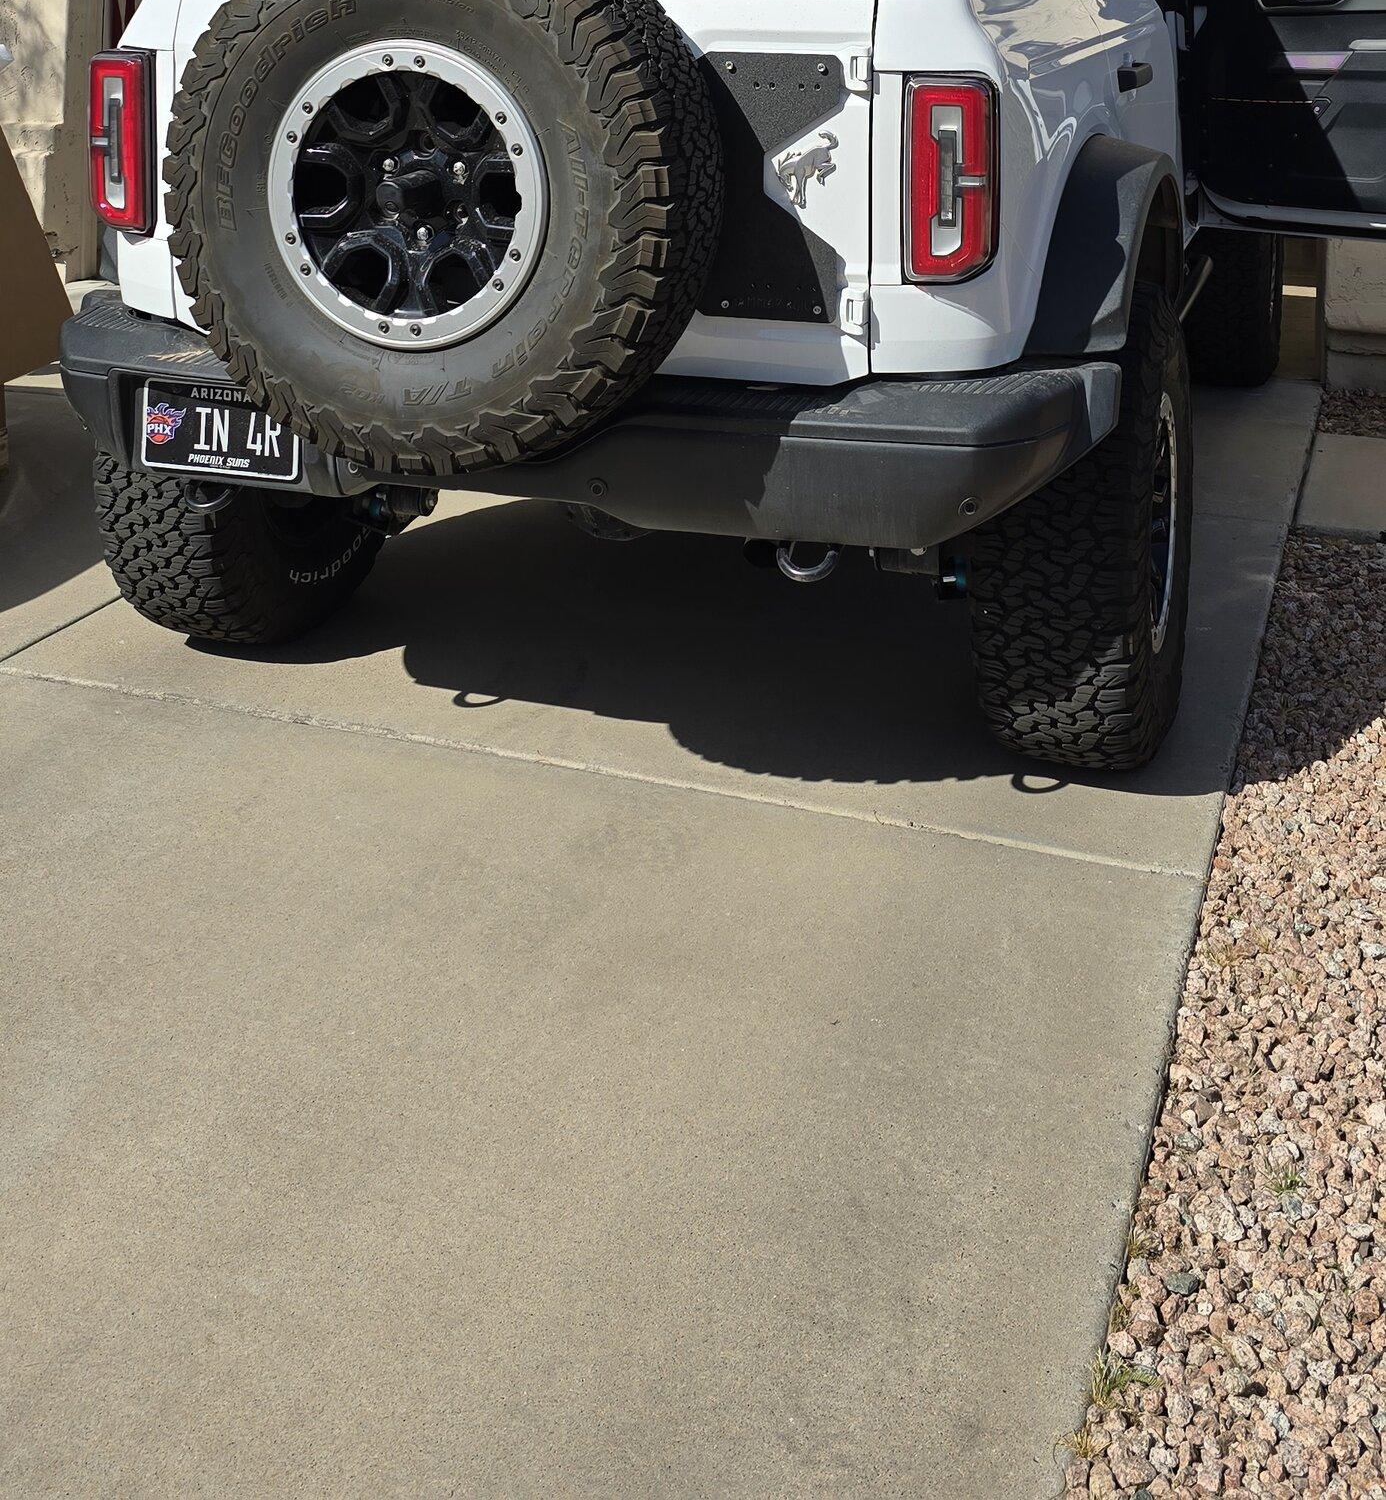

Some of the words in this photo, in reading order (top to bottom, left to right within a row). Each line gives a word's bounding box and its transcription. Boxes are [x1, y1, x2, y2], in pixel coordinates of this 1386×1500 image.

[490, 117, 590, 379] All-Terrain
[190, 387, 252, 403] ARIZONA
[147, 423, 172, 435] PHX
[194, 406, 230, 452] IN
[246, 411, 282, 458] 4R
[188, 453, 224, 466] PHOENIX
[226, 456, 251, 469] SUNS
